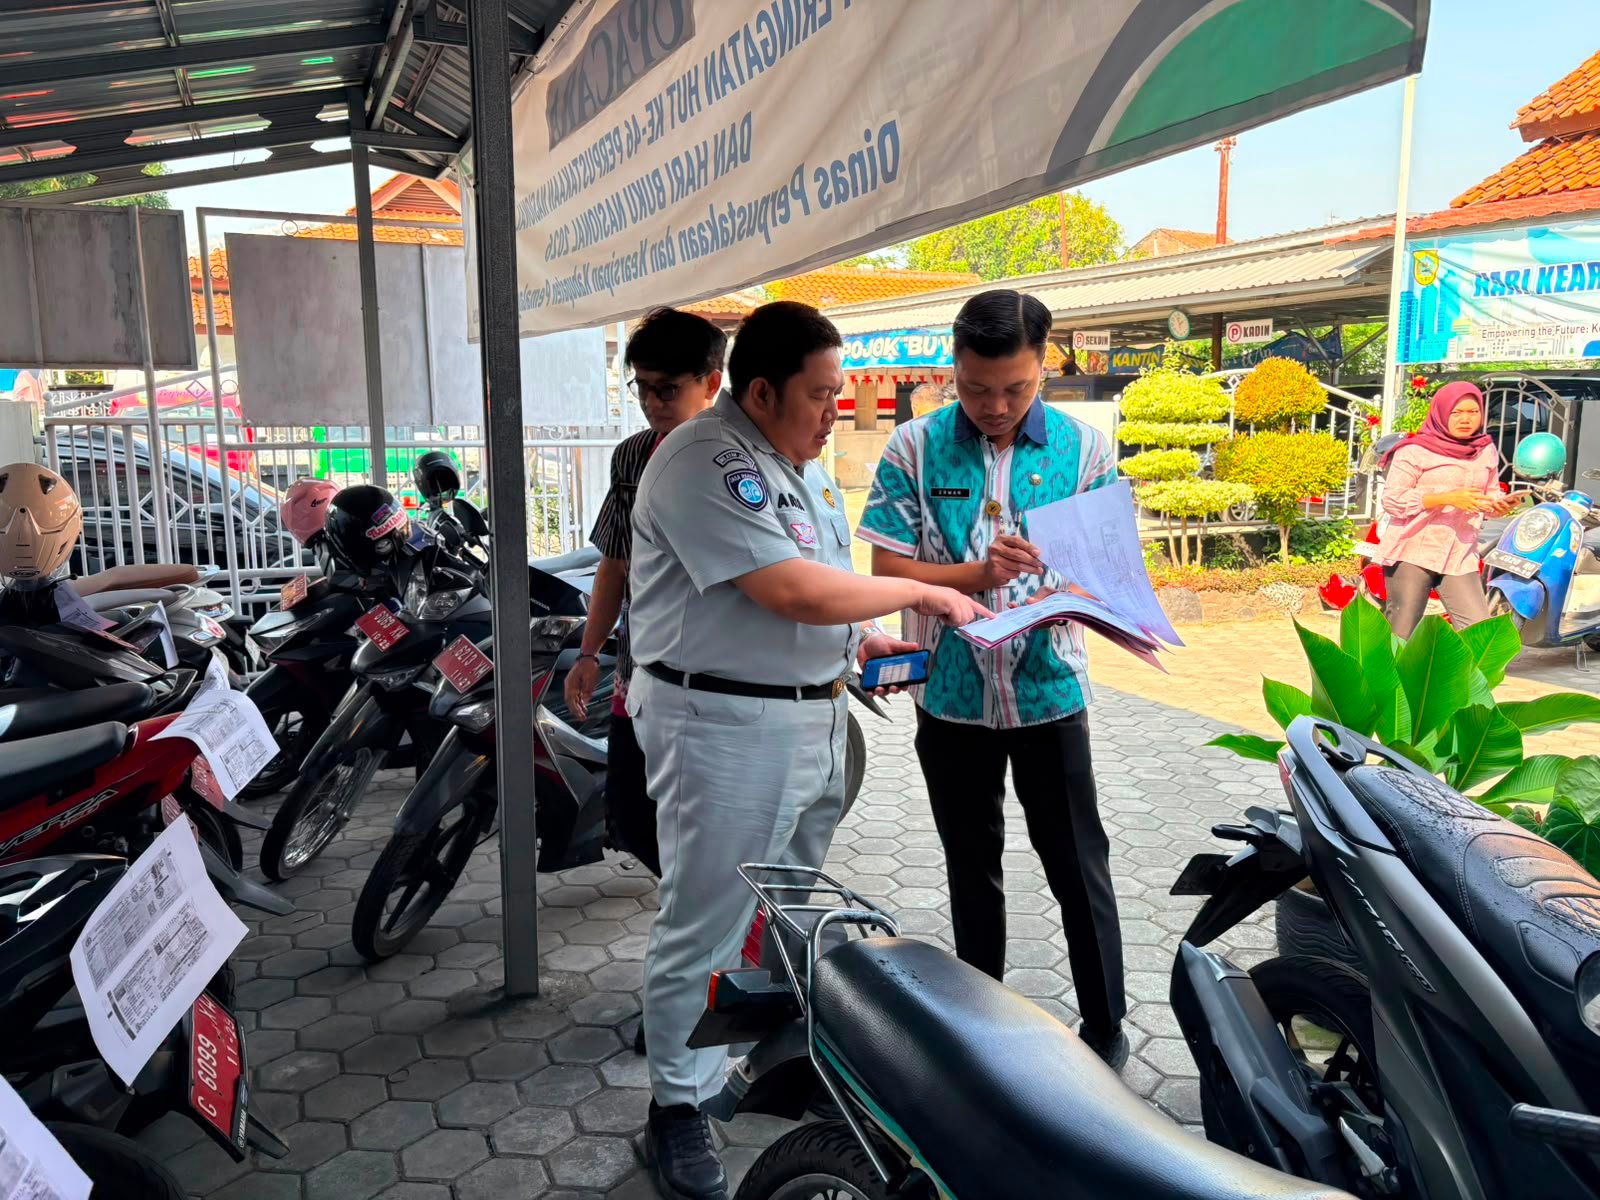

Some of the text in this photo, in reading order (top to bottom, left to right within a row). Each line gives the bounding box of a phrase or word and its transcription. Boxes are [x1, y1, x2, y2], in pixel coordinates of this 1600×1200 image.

[1473, 269, 1531, 296] HARI
[1243, 325, 1270, 338] KADIN
[1481, 327, 1536, 339] Empowering
[1538, 326, 1553, 336] the
[1555, 325, 1589, 335] Future:
[841, 336, 900, 359] POJOK
[1112, 350, 1161, 368] KANTIN
[197, 1033, 217, 1091] 6099
[197, 1095, 217, 1118] G
